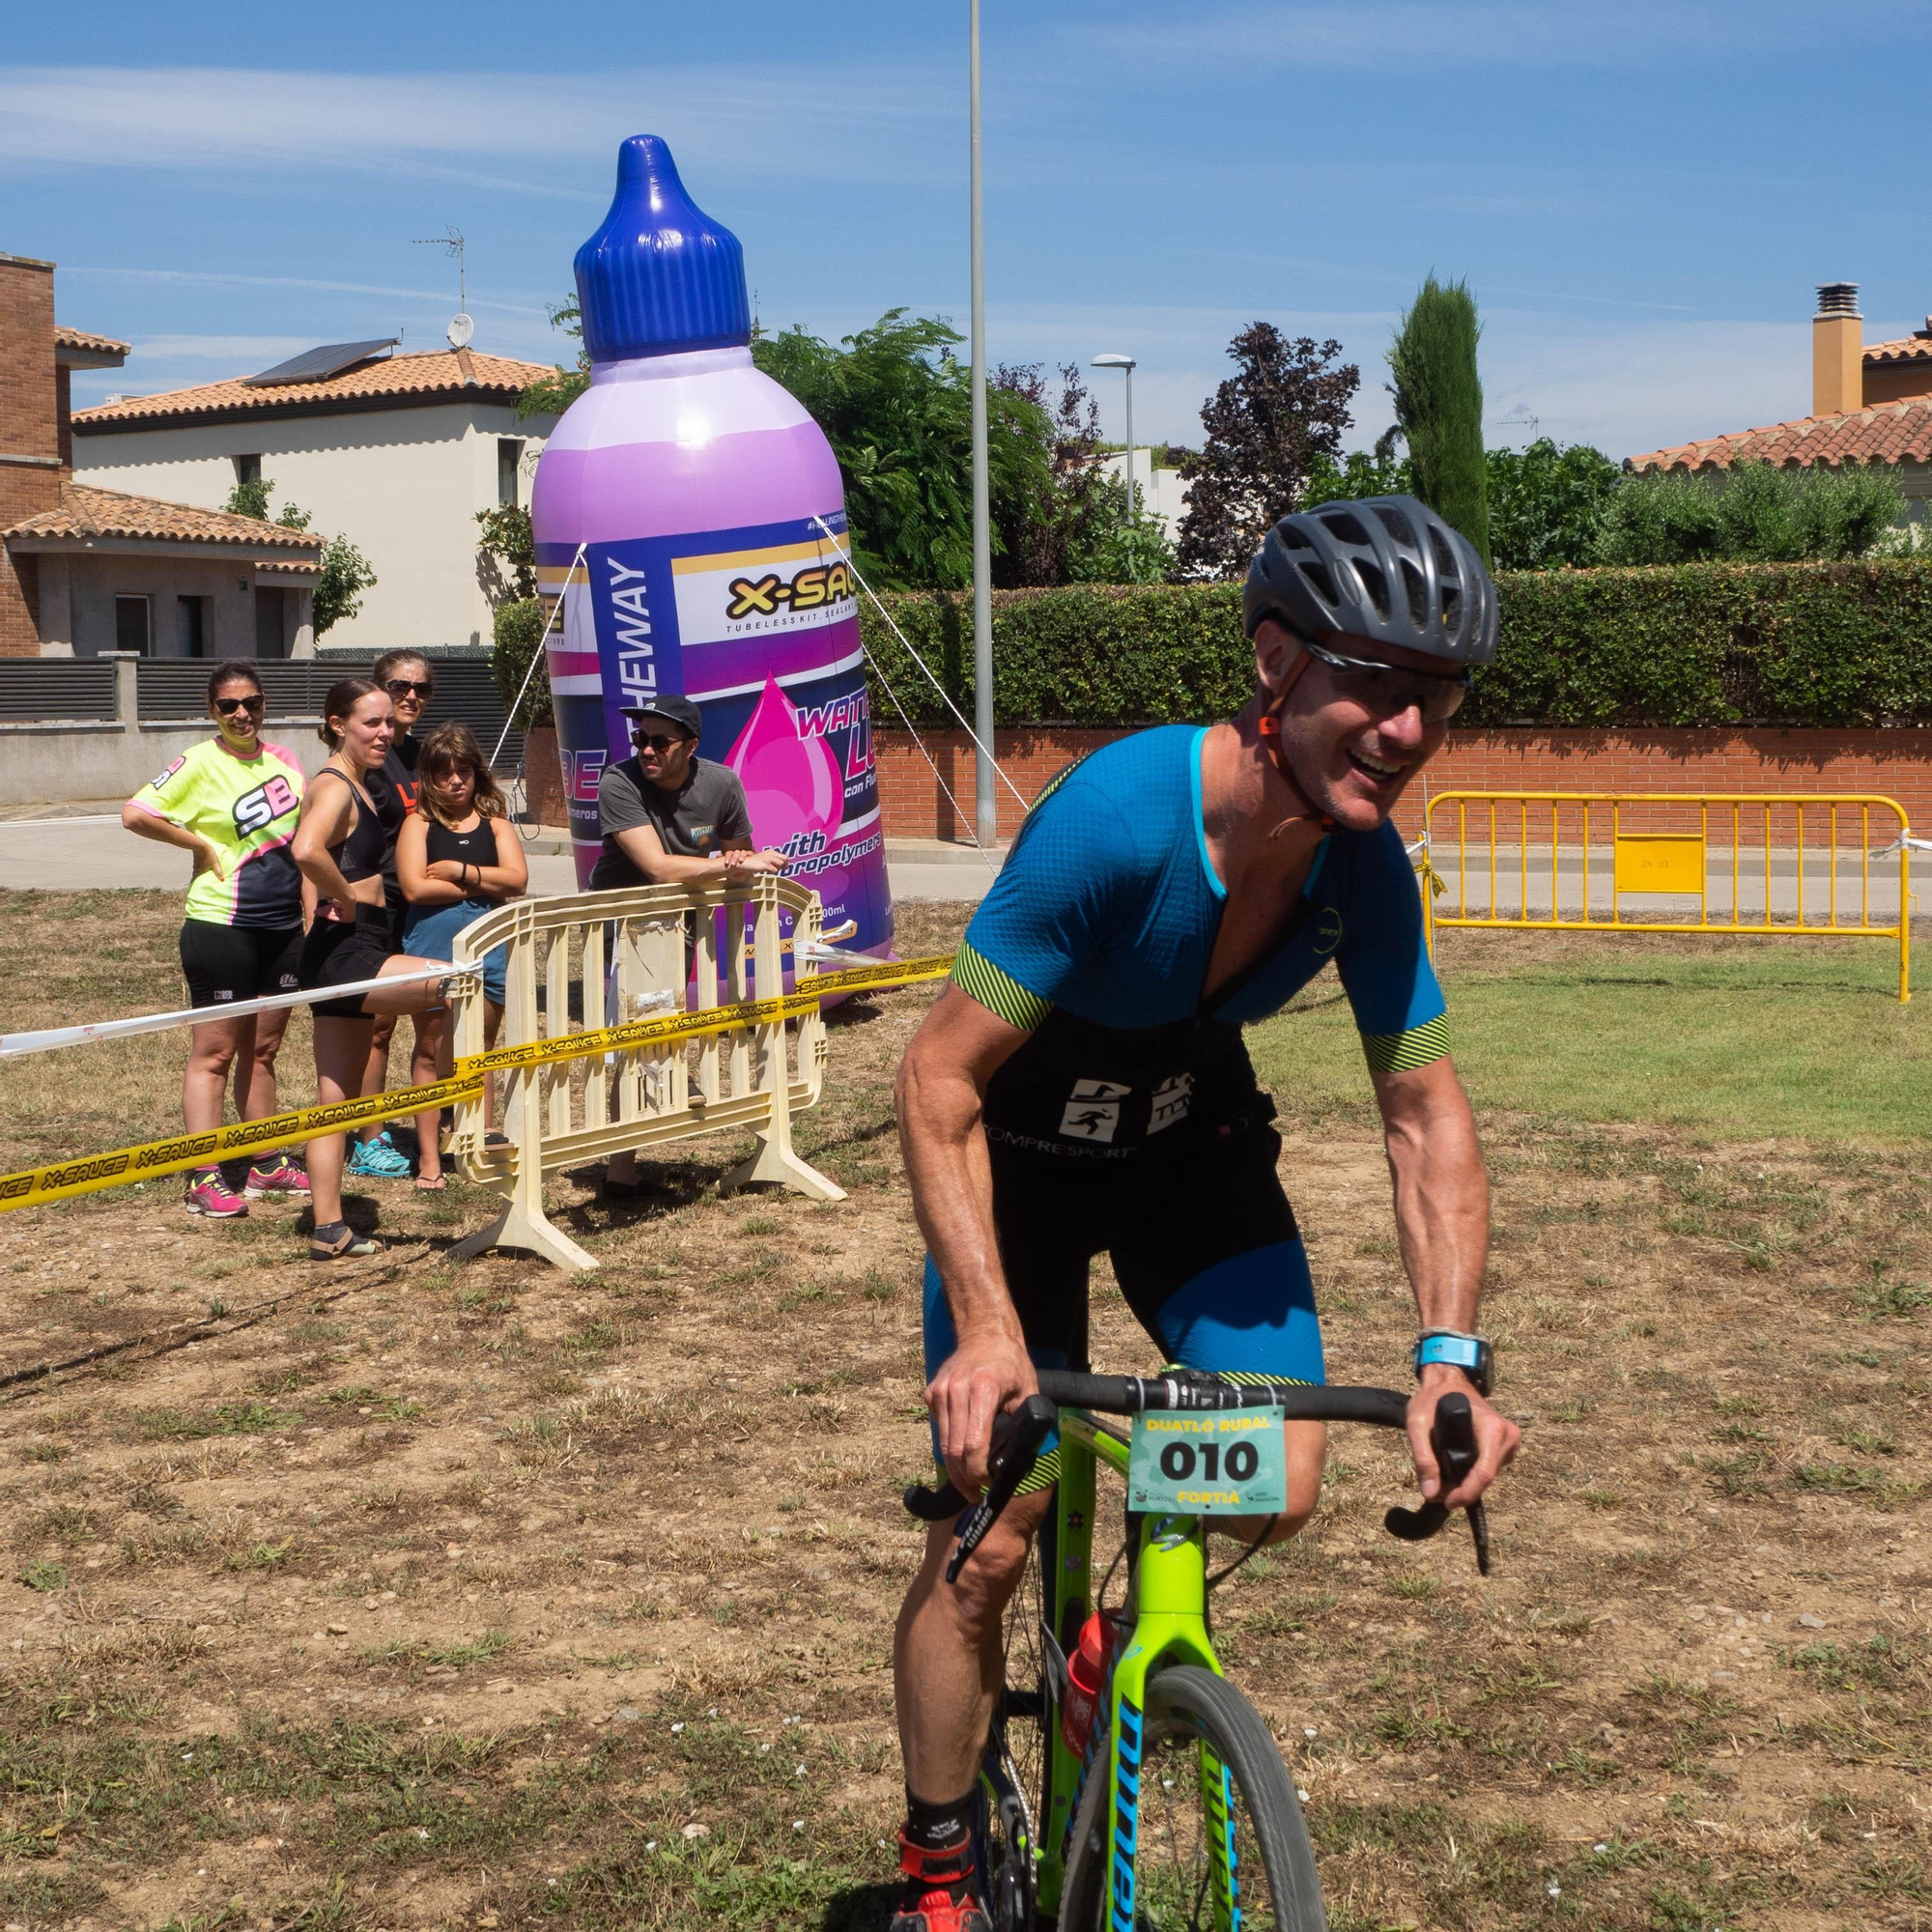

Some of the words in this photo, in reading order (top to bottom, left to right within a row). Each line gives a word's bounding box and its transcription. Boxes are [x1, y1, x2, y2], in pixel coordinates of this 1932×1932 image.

[607, 556, 658, 757] THEWAY
[232, 774, 299, 840] SB
[844, 782, 863, 798] con
[780, 831, 881, 877] oropolymers
[469, 1047, 537, 1069] X-SAUCE
[542, 1035, 602, 1055] X-SAUCE
[608, 1022, 666, 1043] X-SAUCE
[669, 1009, 724, 1033] X-SAUCE
[727, 1001, 778, 1022] X-SAUCE
[42, 1154, 129, 1191] X-SAUCE
[136, 1134, 217, 1170] X-SAUCE
[223, 1116, 298, 1149] X-SAUCE
[304, 1099, 376, 1130] X-SAUCE
[381, 1084, 447, 1112] X-SAUCE
[1219, 1415, 1271, 1432] RURAL
[1160, 1441, 1259, 1482] 010
[966, 1508, 993, 1548] SRAM
